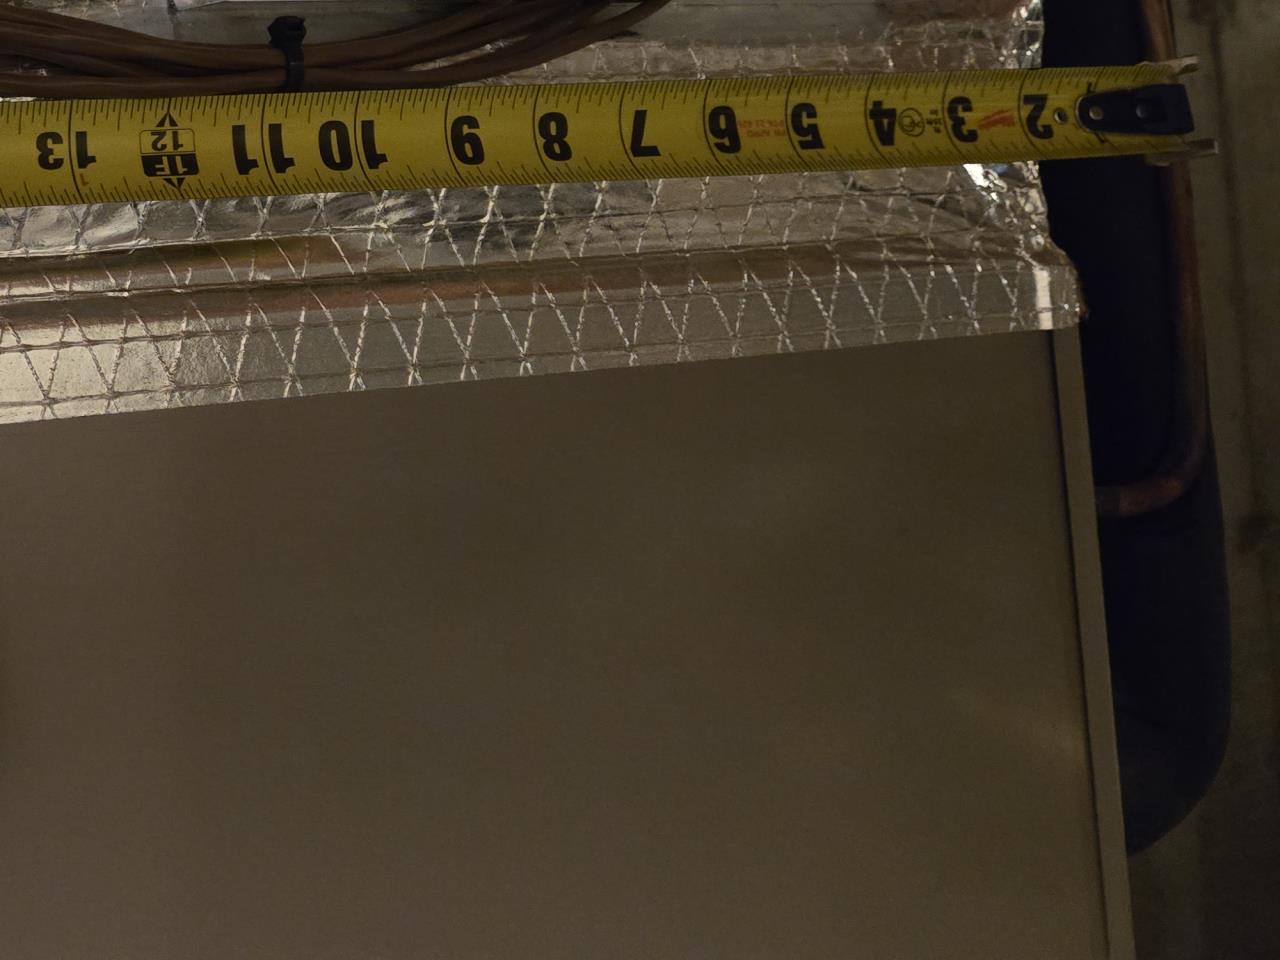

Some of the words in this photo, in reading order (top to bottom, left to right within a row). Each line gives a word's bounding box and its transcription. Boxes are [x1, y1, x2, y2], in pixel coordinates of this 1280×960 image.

[449, 114, 486, 166] 9
[537, 111, 574, 162] 8
[629, 109, 662, 158] 7
[707, 104, 742, 154] 6
[790, 102, 826, 150] 5
[869, 99, 897, 147] 4
[946, 95, 979, 143] 3
[1022, 93, 1054, 140] 2
[35, 130, 97, 171] 13
[150, 130, 184, 152] 12
[154, 154, 190, 176] 1F
[231, 122, 296, 176] 11
[318, 118, 389, 172] 10
